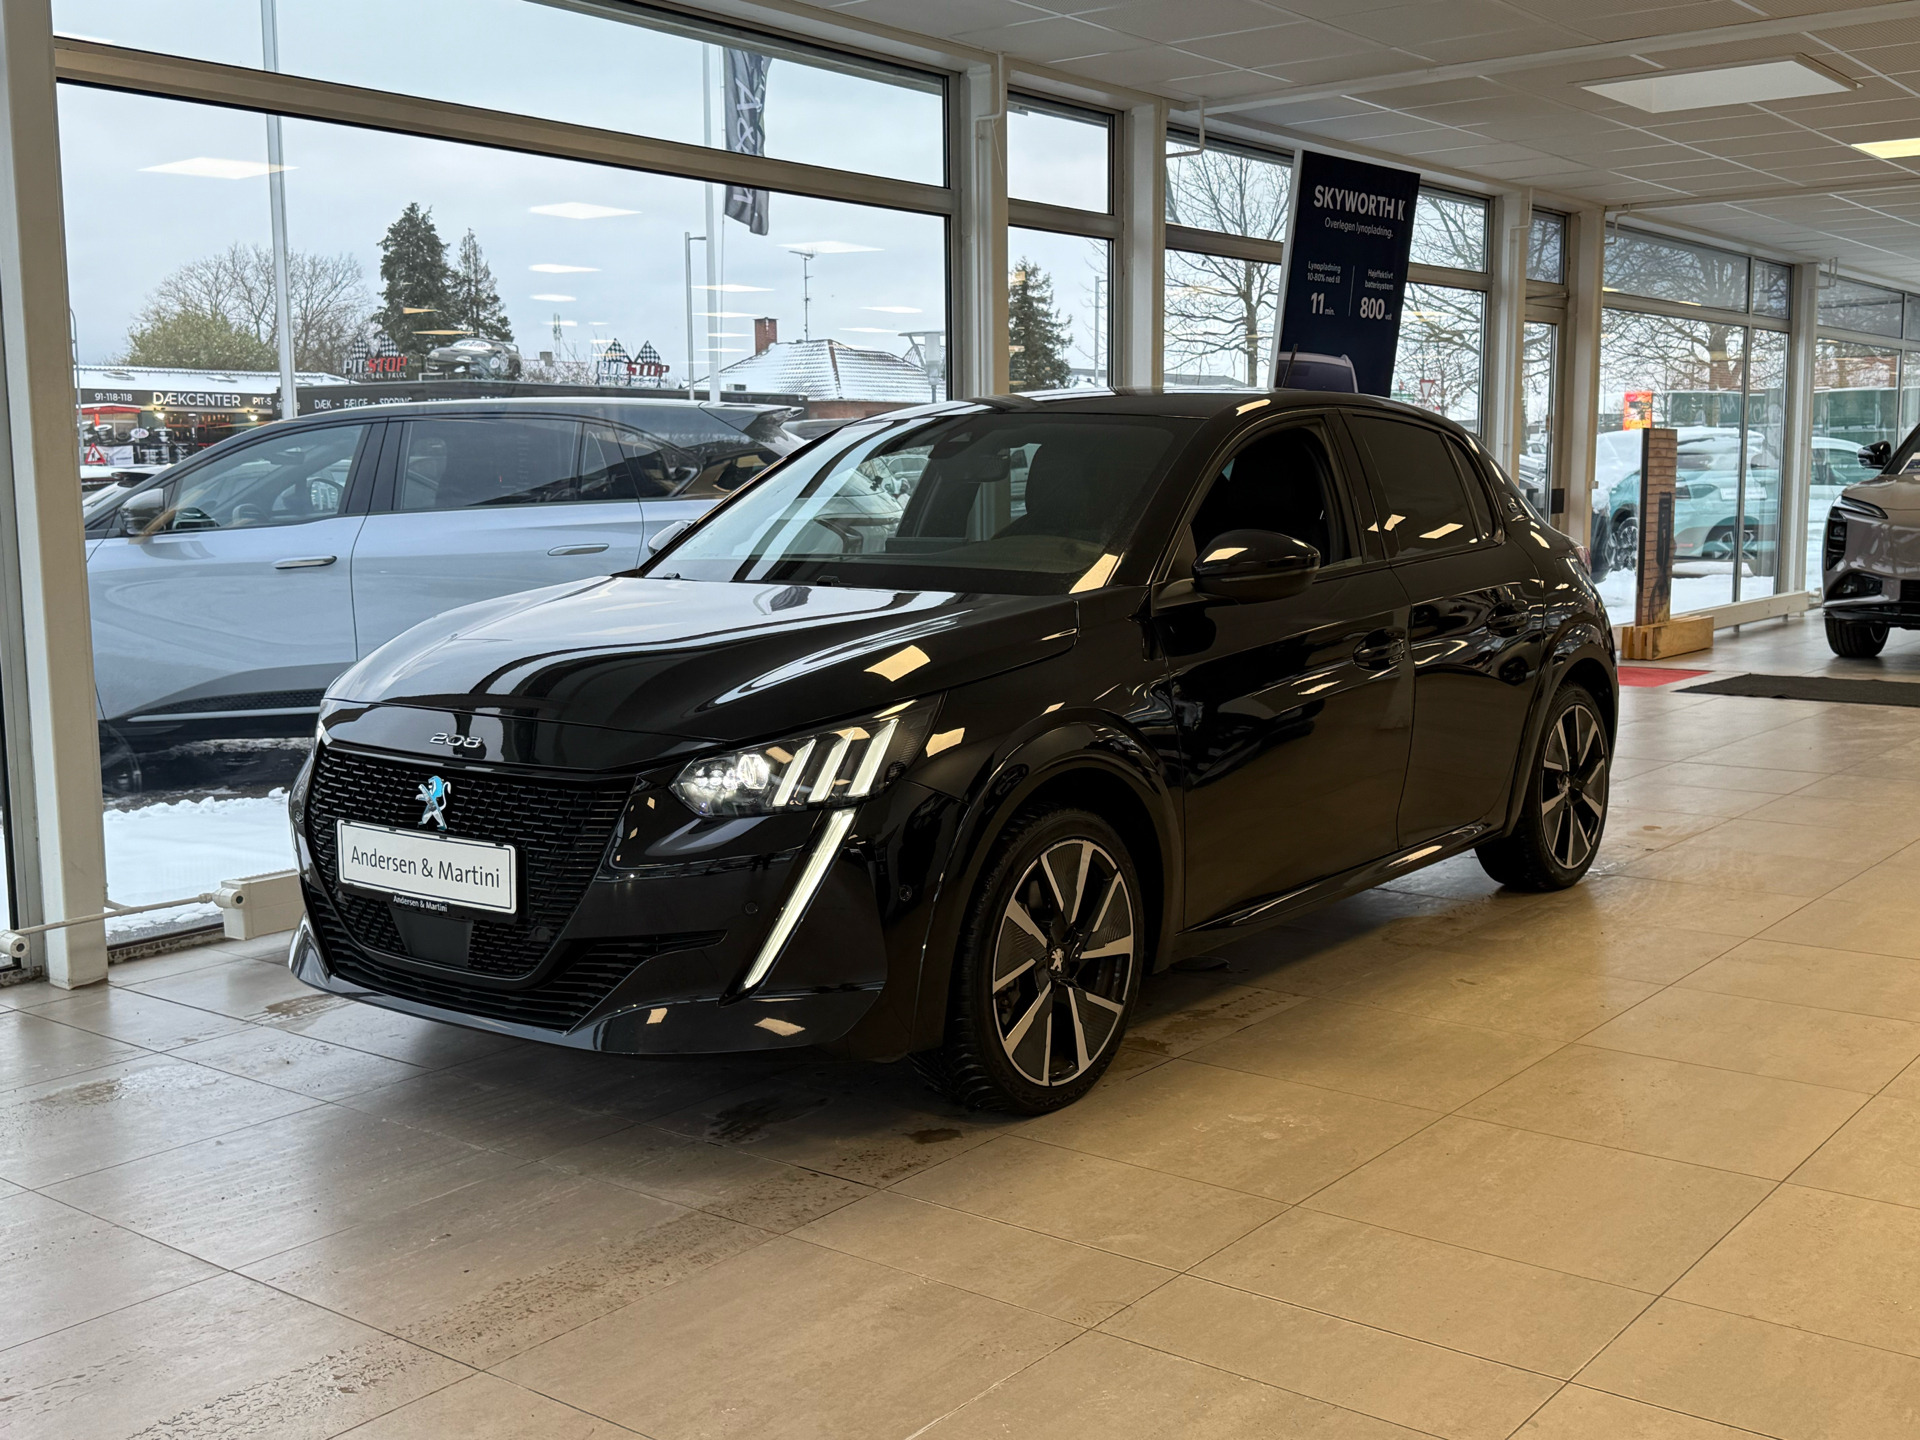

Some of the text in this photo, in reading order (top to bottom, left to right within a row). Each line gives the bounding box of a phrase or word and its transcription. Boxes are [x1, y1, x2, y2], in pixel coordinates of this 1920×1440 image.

[1313, 184, 1406, 221] SKYWORTH K
[1324, 217, 1355, 233] Overlegen
[1307, 261, 1341, 274] Lynopladning
[1307, 272, 1325, 283] 10-80%
[1325, 275, 1335, 284] ned
[1310, 292, 1325, 315] 11
[1360, 296, 1386, 320] 800
[343, 356, 408, 374] PIT STOP
[94, 392, 133, 402] 91-118-118
[153, 391, 241, 407] DÆKCENTER
[314, 399, 332, 410] DÆK
[429, 732, 483, 748] 208
[351, 845, 500, 888] Andersen & Martini
[393, 895, 448, 913] Andersen & Martini
